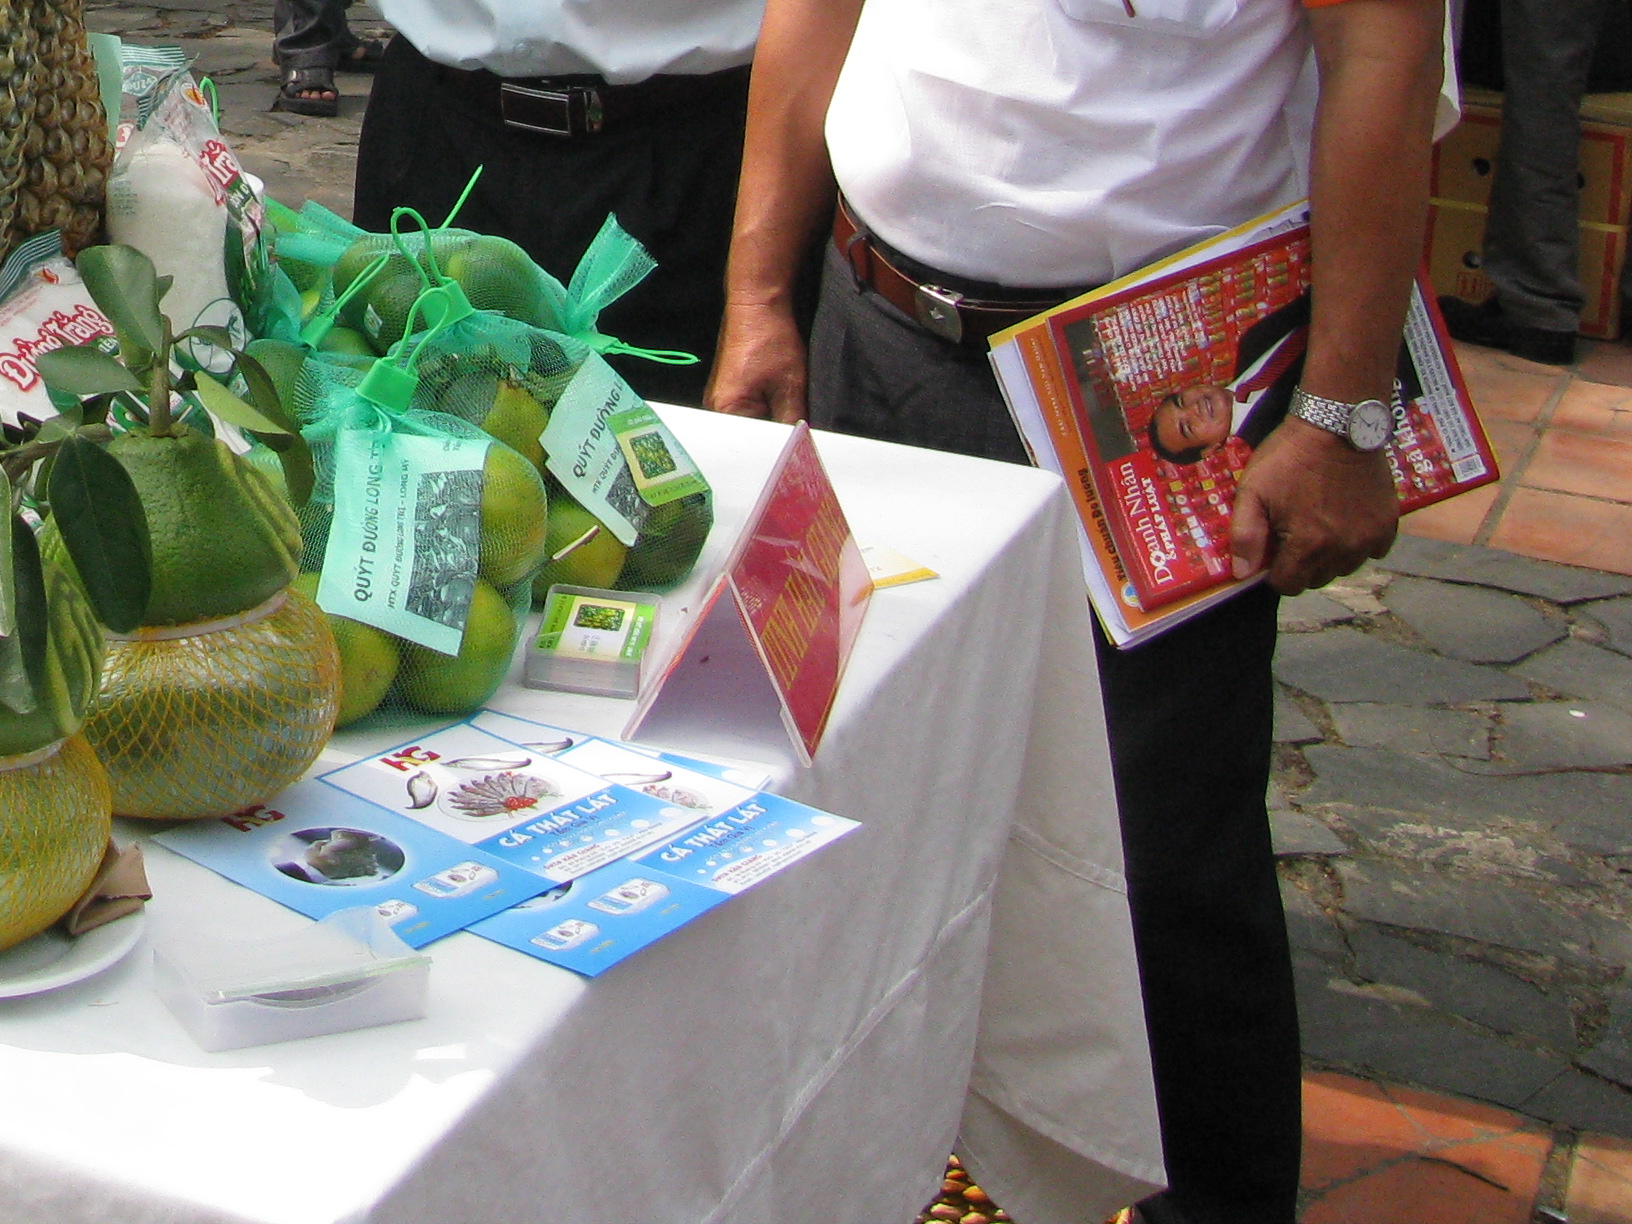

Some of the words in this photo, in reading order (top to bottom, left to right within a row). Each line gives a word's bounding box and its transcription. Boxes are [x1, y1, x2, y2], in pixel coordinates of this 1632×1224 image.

[563, 434, 602, 480] QUÝT
[364, 463, 385, 505] LONG
[1114, 459, 1149, 517] Nhân
[1139, 473, 1163, 513] LUẬT
[356, 506, 382, 553] ĐƯỜNG
[1132, 514, 1175, 587] Doanh
[349, 555, 377, 603] QUÝT
[487, 828, 537, 849] CÁ
[518, 807, 587, 835] THÁT
[565, 791, 625, 814] LÁT
[671, 819, 743, 848] THÁT
[717, 801, 776, 824] LÁT
[646, 842, 698, 863] CÁ
